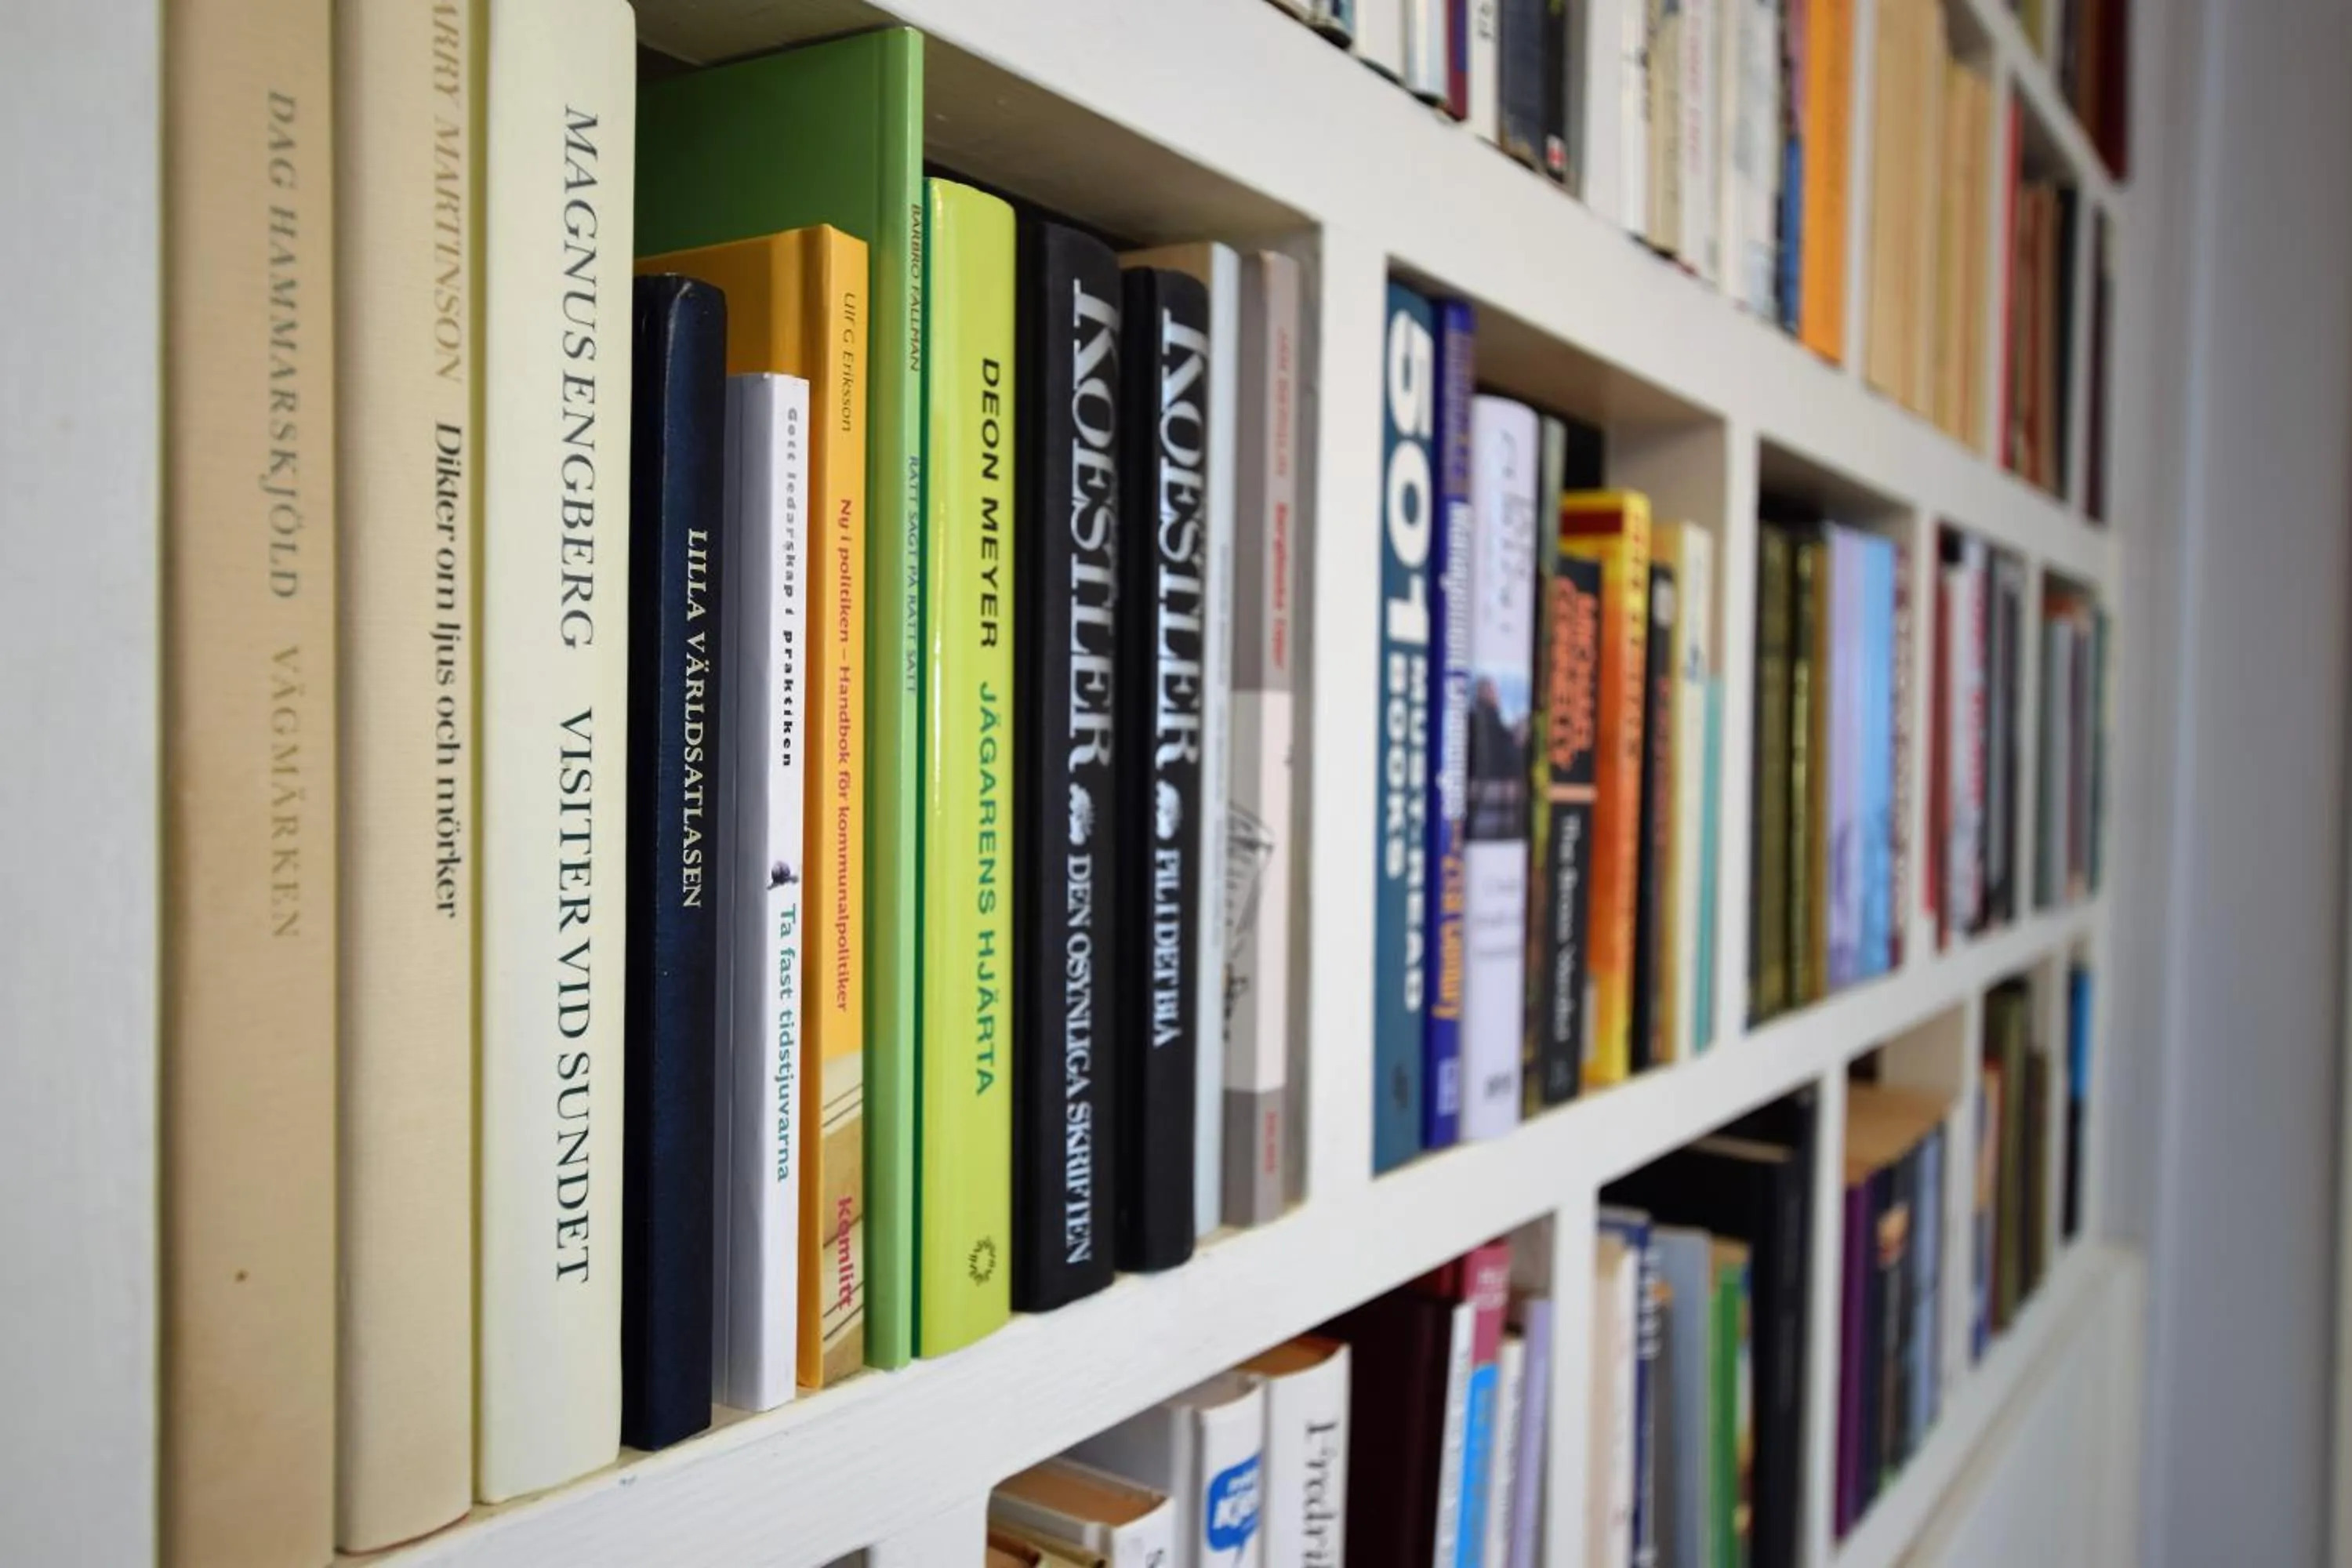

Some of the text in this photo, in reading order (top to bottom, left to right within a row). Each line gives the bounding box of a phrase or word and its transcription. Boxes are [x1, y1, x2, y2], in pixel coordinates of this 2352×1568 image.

[431, 115, 463, 383] MARTINSON
[911, 203, 920, 280] BARBRO
[842, 329, 855, 343] G
[843, 291, 856, 324] Ulf
[786, 407, 798, 462] Gott
[841, 350, 855, 433] Eriksson
[260, 89, 307, 938] DAG HAMMARSKJÖLD VÄGMÄRKEN
[434, 422, 463, 541] Dikter
[784, 471, 797, 599] ledarskap
[837, 499, 851, 528] Ny
[908, 511, 920, 557] SAGT
[1387, 310, 1434, 644] 501
[435, 547, 456, 611] om
[838, 546, 852, 644] politiken
[1156, 308, 1210, 770] KOESTLER
[429, 621, 462, 686] ljus
[555, 104, 598, 1283] MAGNUS ENGBERG VISITER VID SUNDET
[782, 628, 793, 768] praktiken
[435, 695, 461, 767] och
[681, 528, 710, 909] LILLA VÄRLDSATLASEN
[837, 666, 851, 764] Handbok
[976, 358, 1001, 1096] DEON MEYER JÄGARENS HJÄRTA
[1065, 278, 1122, 1265] KOESTLER DEN OSYNLIGA SKRIFTEN
[1386, 652, 1407, 879] BOOKS
[837, 770, 851, 801] för
[435, 775, 462, 918] mörker
[1155, 848, 1181, 901] PIL
[834, 806, 851, 1012] kommunalpolitiker
[1154, 920, 1181, 985] DET
[773, 902, 797, 1183] Ta fast tidstjuvarna
[1301, 1419, 1338, 1568] Fredri
